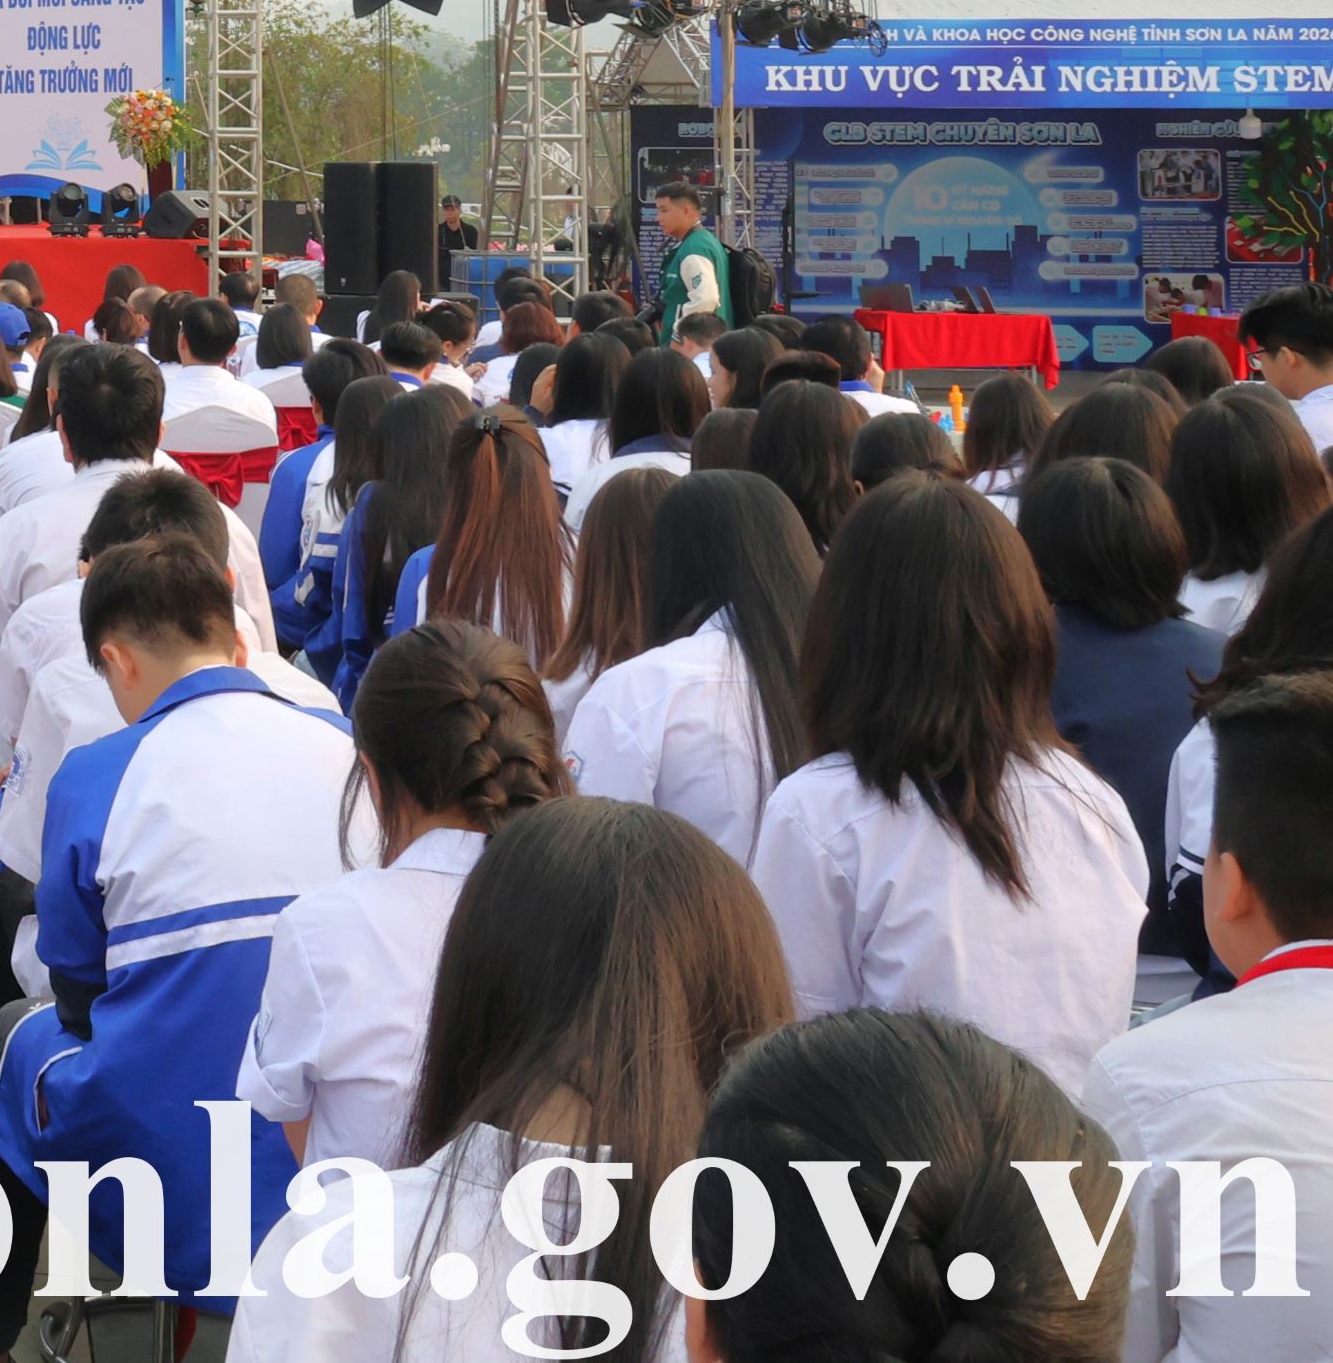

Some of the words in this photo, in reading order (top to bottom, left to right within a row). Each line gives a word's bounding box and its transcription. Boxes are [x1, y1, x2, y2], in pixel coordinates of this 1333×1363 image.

[27, 21, 68, 56] ĐỘNG
[73, 22, 101, 55] LỰC
[904, 25, 927, 41] VÀ
[934, 28, 981, 41] KHOA
[986, 28, 1026, 44] HỌC
[1030, 25, 1084, 41] CÔNG
[1089, 25, 1137, 45] NGHỆ
[1142, 24, 1181, 41] TỈNH
[1186, 26, 1222, 41] SƠN
[1228, 28, 1248, 41] LA
[1253, 24, 1294, 41] NĂM
[1299, 27, 1333, 41] 202
[40, 60, 98, 93] TRƯỞNG
[104, 63, 133, 93] MỚI
[765, 65, 849, 92] KHU
[859, 65, 940, 98] VỰC
[951, 56, 1046, 92] TRẢI
[1057, 60, 1221, 99] NGHIỆM
[1233, 65, 1333, 93] STEM
[870, 123, 929, 145] STEM
[1069, 123, 1102, 145] LA
